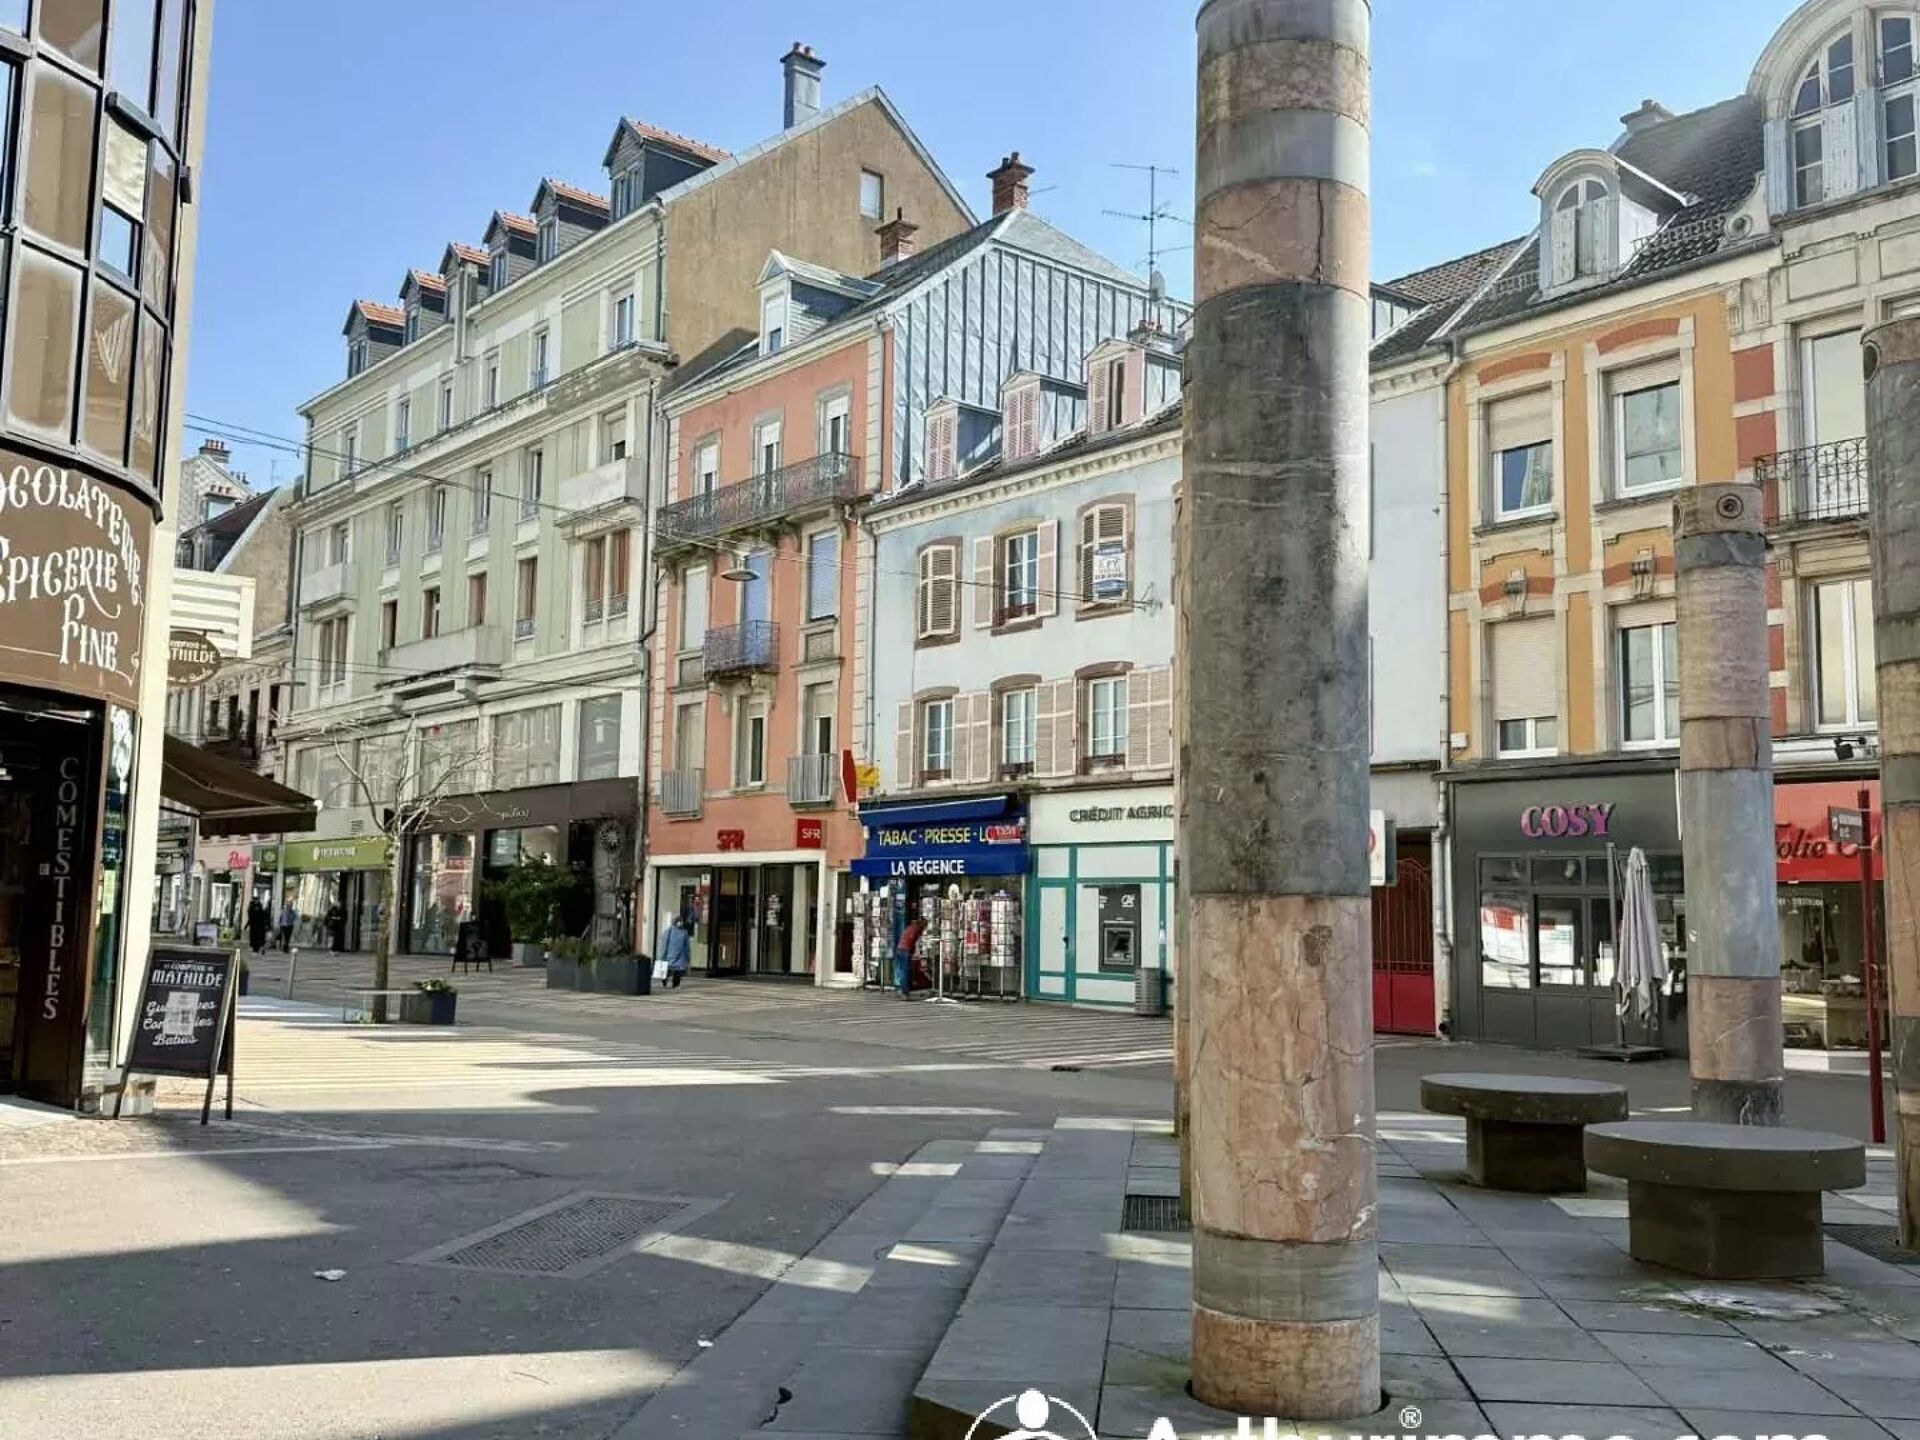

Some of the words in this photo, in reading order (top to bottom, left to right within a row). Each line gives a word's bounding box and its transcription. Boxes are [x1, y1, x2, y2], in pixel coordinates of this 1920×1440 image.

[59, 593, 119, 672] FINE
[169, 648, 217, 664] THILDE
[1069, 807, 1125, 823] CRÉDIT
[1127, 804, 1174, 820] AGRIC
[1520, 803, 1614, 836] COSY
[801, 828, 821, 839] SFR
[878, 830, 917, 846] TABAC
[924, 827, 970, 844] PRESSE
[890, 861, 905, 875] LA
[908, 857, 965, 875] RÉGENCE
[42, 756, 80, 1020] COMESTIBLES
[151, 970, 224, 987] MATHILDE
